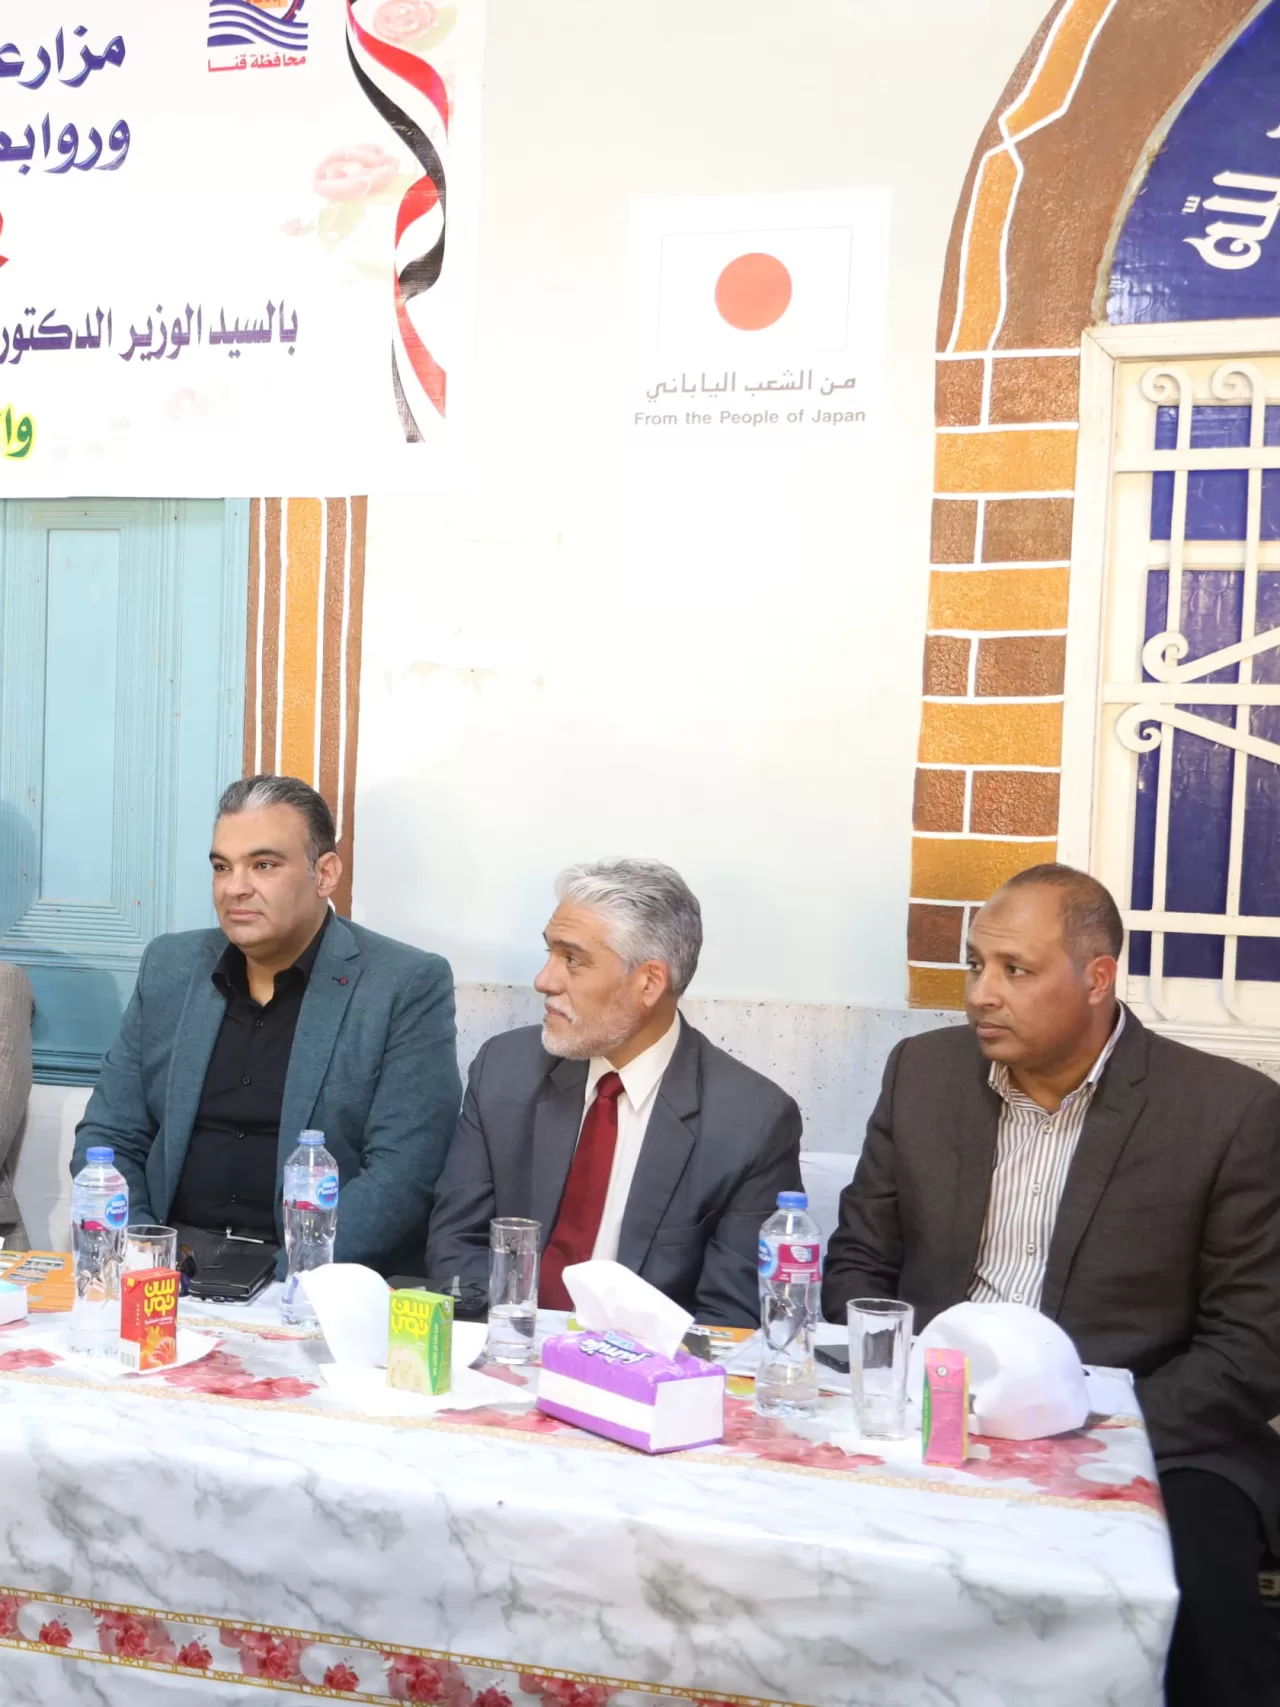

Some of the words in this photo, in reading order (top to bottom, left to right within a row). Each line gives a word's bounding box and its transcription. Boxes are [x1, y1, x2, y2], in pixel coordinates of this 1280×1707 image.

[250, 52, 307, 69] محافظة
[118, 301, 202, 363] الوزير
[208, 298, 298, 360] بالسيد
[646, 370, 737, 404] الياباني
[744, 369, 814, 398] الشعب
[819, 375, 857, 396] من
[633, 411, 678, 426] From
[685, 411, 712, 425] the
[719, 409, 779, 427] People
[786, 409, 805, 423] of
[811, 409, 866, 427] Japan
[144, 1277, 176, 1298] سن
[144, 1294, 176, 1318] توب
[391, 1297, 431, 1320] سن
[391, 1314, 430, 1341] توب
